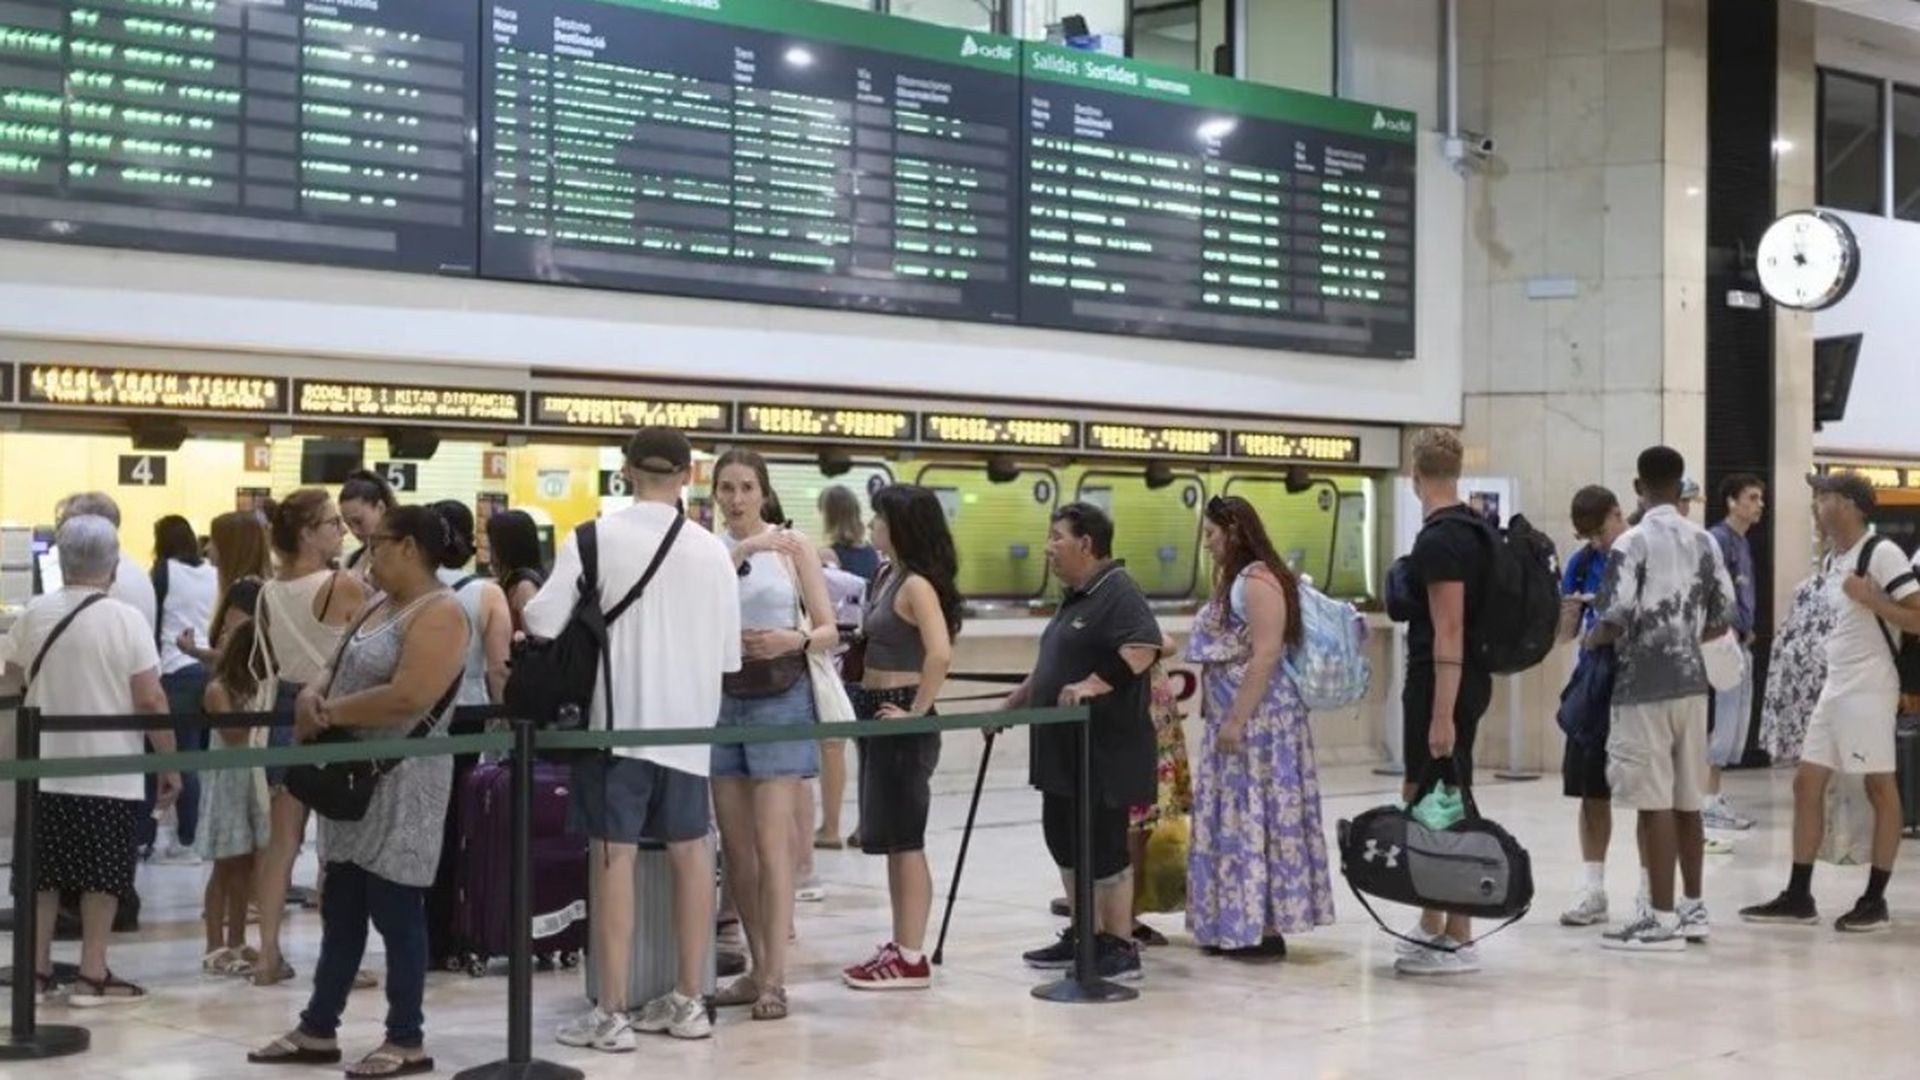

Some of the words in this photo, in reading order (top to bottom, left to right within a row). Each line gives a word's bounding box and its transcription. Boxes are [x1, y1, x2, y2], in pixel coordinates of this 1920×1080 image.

[979, 44, 1014, 60] adif
[1032, 52, 1078, 75] Salidas
[1085, 61, 1139, 86] Sortides
[31, 367, 100, 388] LOCAL
[112, 370, 178, 392] TRAIN
[188, 375, 276, 397] TICKETS
[254, 446, 270, 467] R
[131, 456, 153, 485] 4
[387, 464, 405, 490] 5
[608, 471, 625, 496] 6
